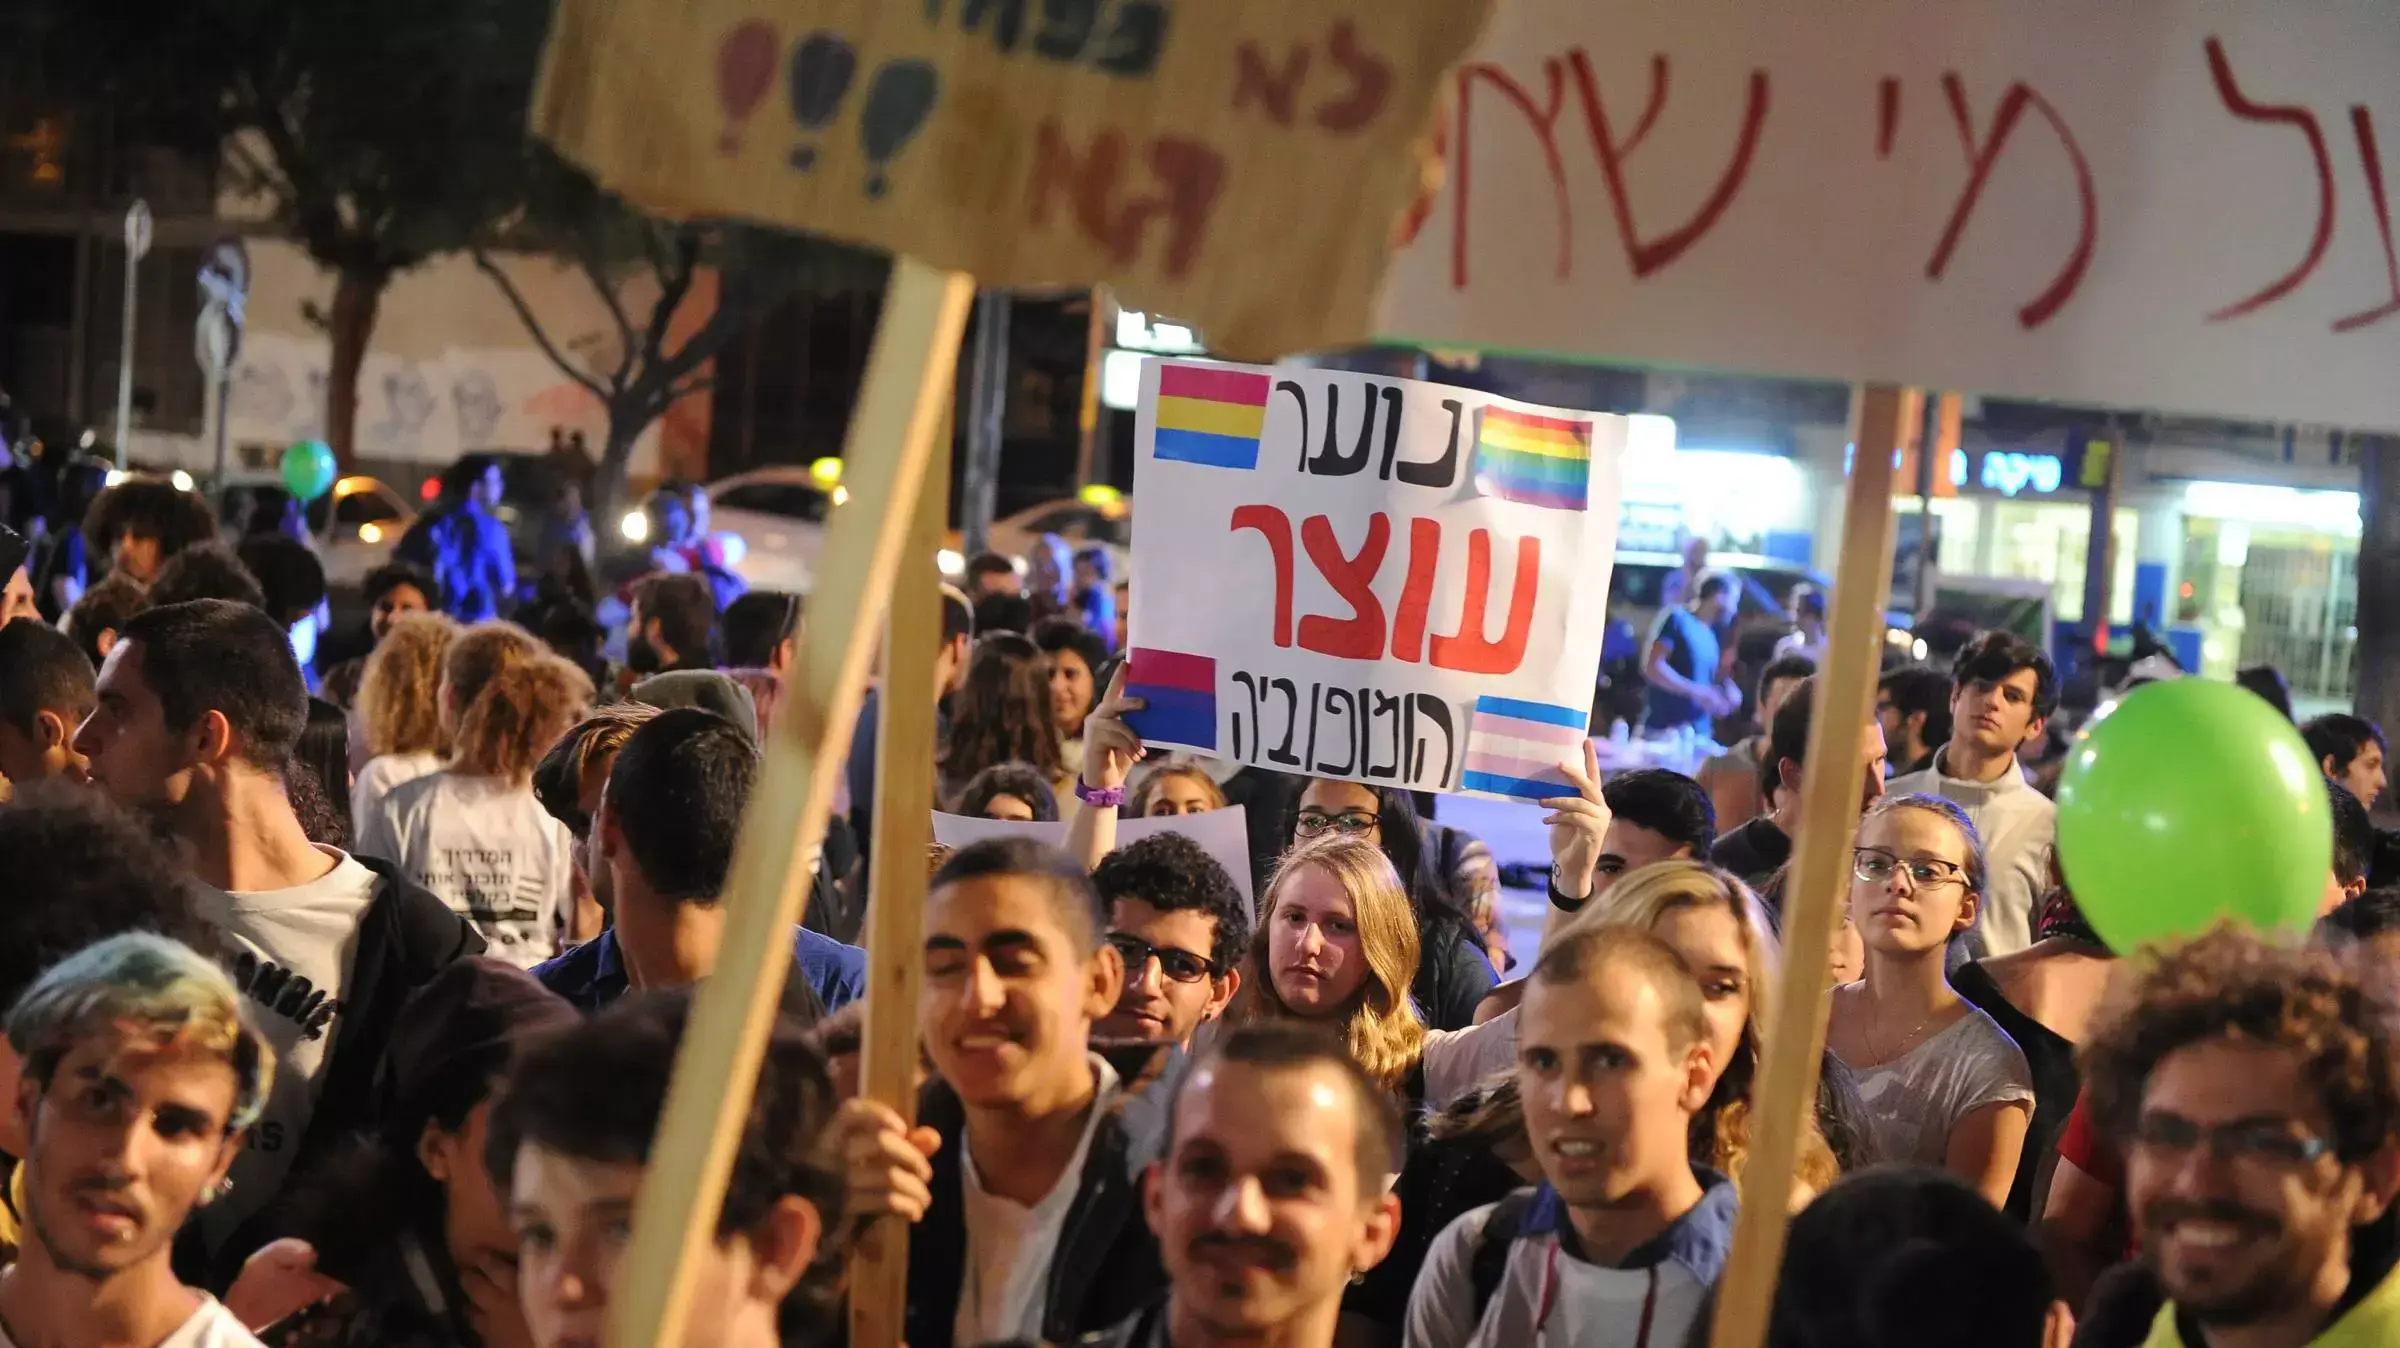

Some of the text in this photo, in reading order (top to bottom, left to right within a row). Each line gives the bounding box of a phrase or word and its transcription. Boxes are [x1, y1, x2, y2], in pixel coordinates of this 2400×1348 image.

[1874, 68, 2098, 330] מי
[1275, 380, 1464, 489] נוער
[1230, 504, 1541, 675] עוצר
[1232, 671, 1454, 789] הומופוביה
